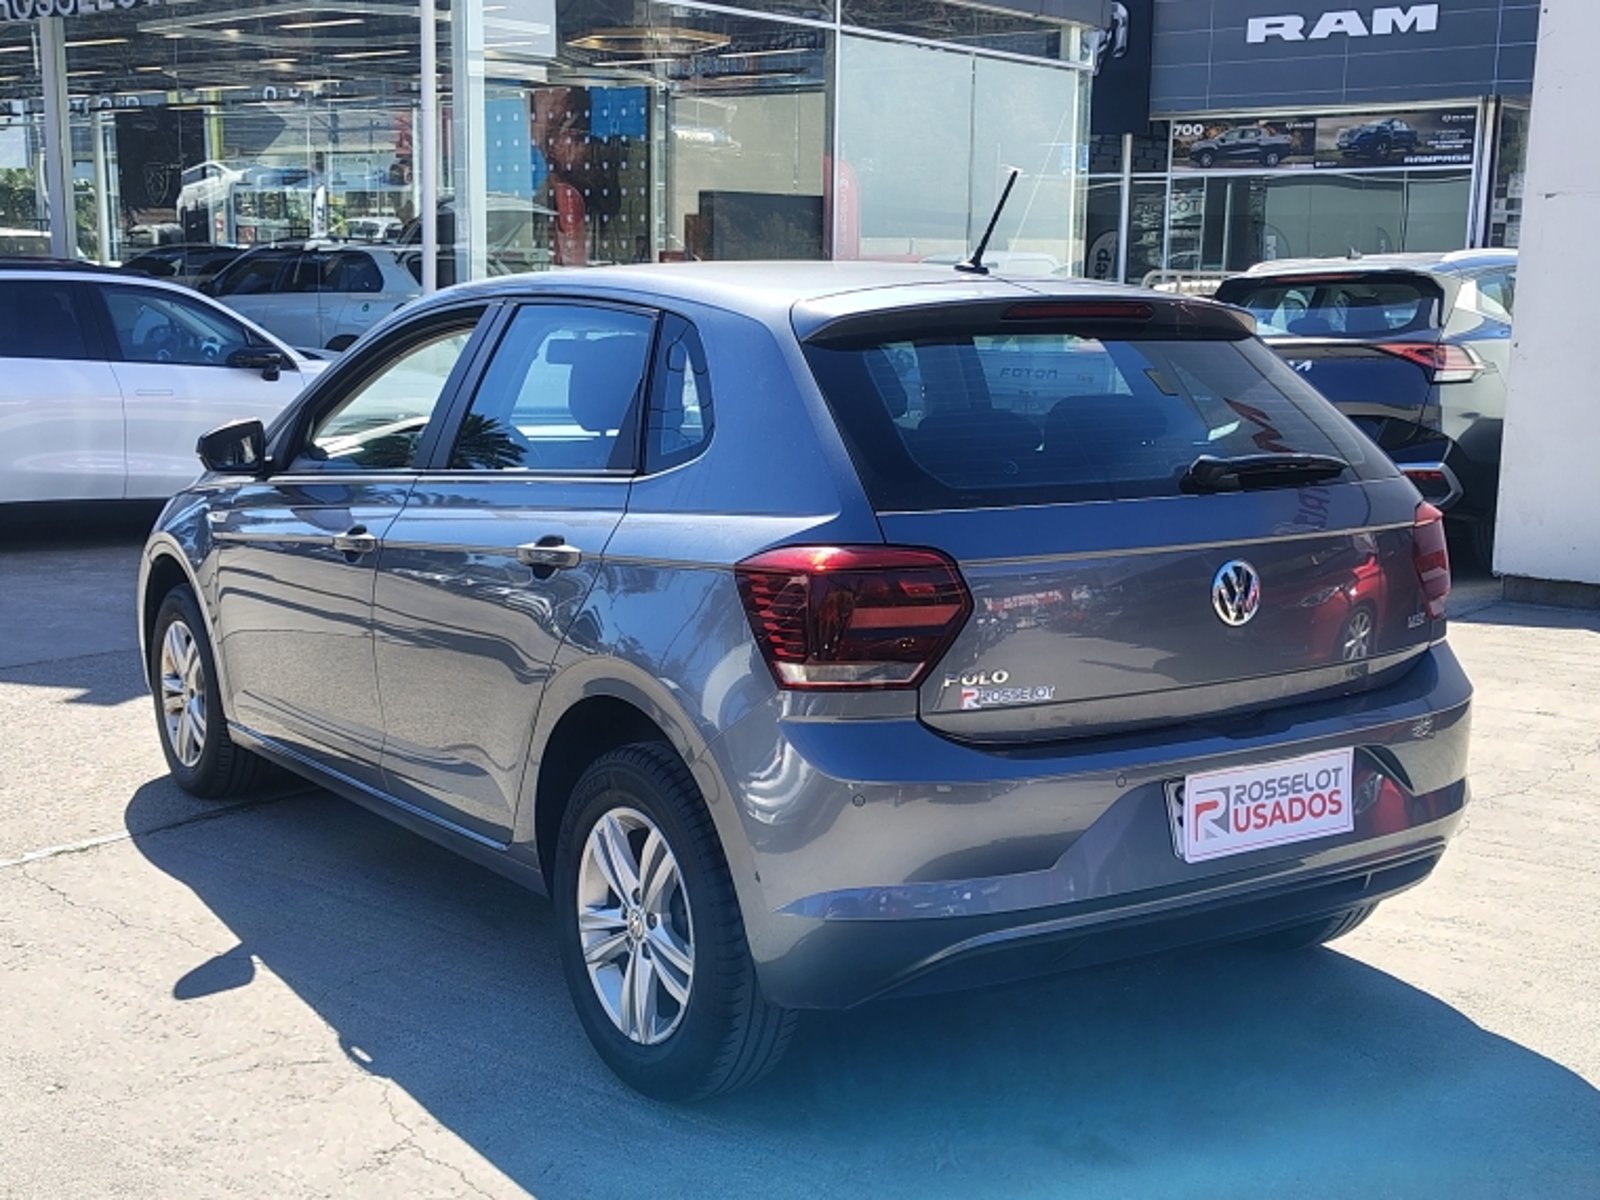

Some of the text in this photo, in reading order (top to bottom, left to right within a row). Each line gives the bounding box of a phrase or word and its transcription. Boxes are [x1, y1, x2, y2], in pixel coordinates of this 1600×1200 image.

[1246, 4, 1439, 43] RAM
[1174, 123, 1204, 136] 700
[943, 669, 1010, 687] POLO
[1233, 766, 1344, 807] ROSSELOT
[1232, 788, 1343, 833] USADOS
